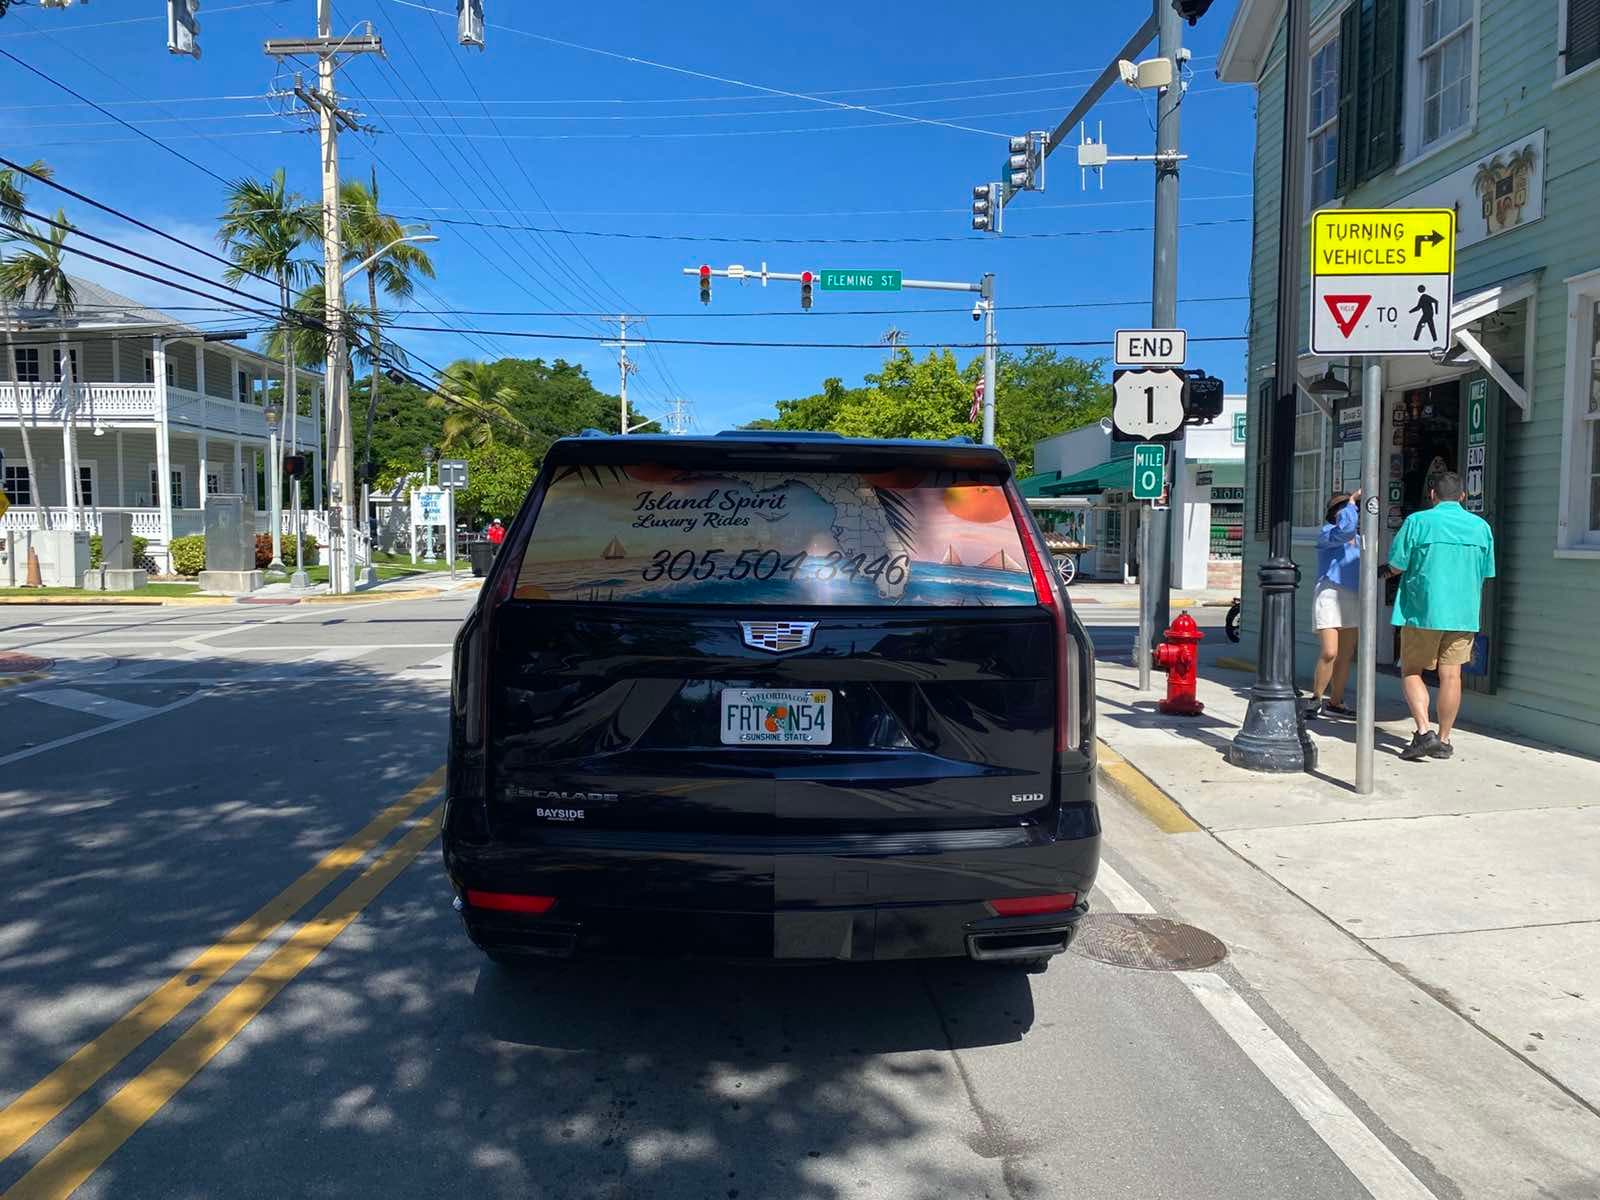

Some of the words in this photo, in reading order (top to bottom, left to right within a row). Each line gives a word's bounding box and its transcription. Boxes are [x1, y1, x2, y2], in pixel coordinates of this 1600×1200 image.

[1326, 223, 1404, 240] TURNING
[1323, 249, 1406, 265] VEHICLES
[827, 274, 873, 287] FLEMING
[1376, 307, 1398, 323] TO
[1129, 338, 1173, 357] END
[1143, 386, 1154, 424] 1
[1136, 453, 1163, 467] MILE
[1142, 471, 1156, 490] 0
[633, 489, 715, 511] Island
[717, 489, 789, 521] Spirit
[632, 513, 698, 532] Luxury
[702, 513, 750, 528] Rides
[727, 704, 764, 731] FRT
[788, 704, 826, 731] N54
[745, 733, 780, 742] SUNSHINE
[784, 733, 807, 742] STATE
[536, 808, 585, 819] BAYSIDE
